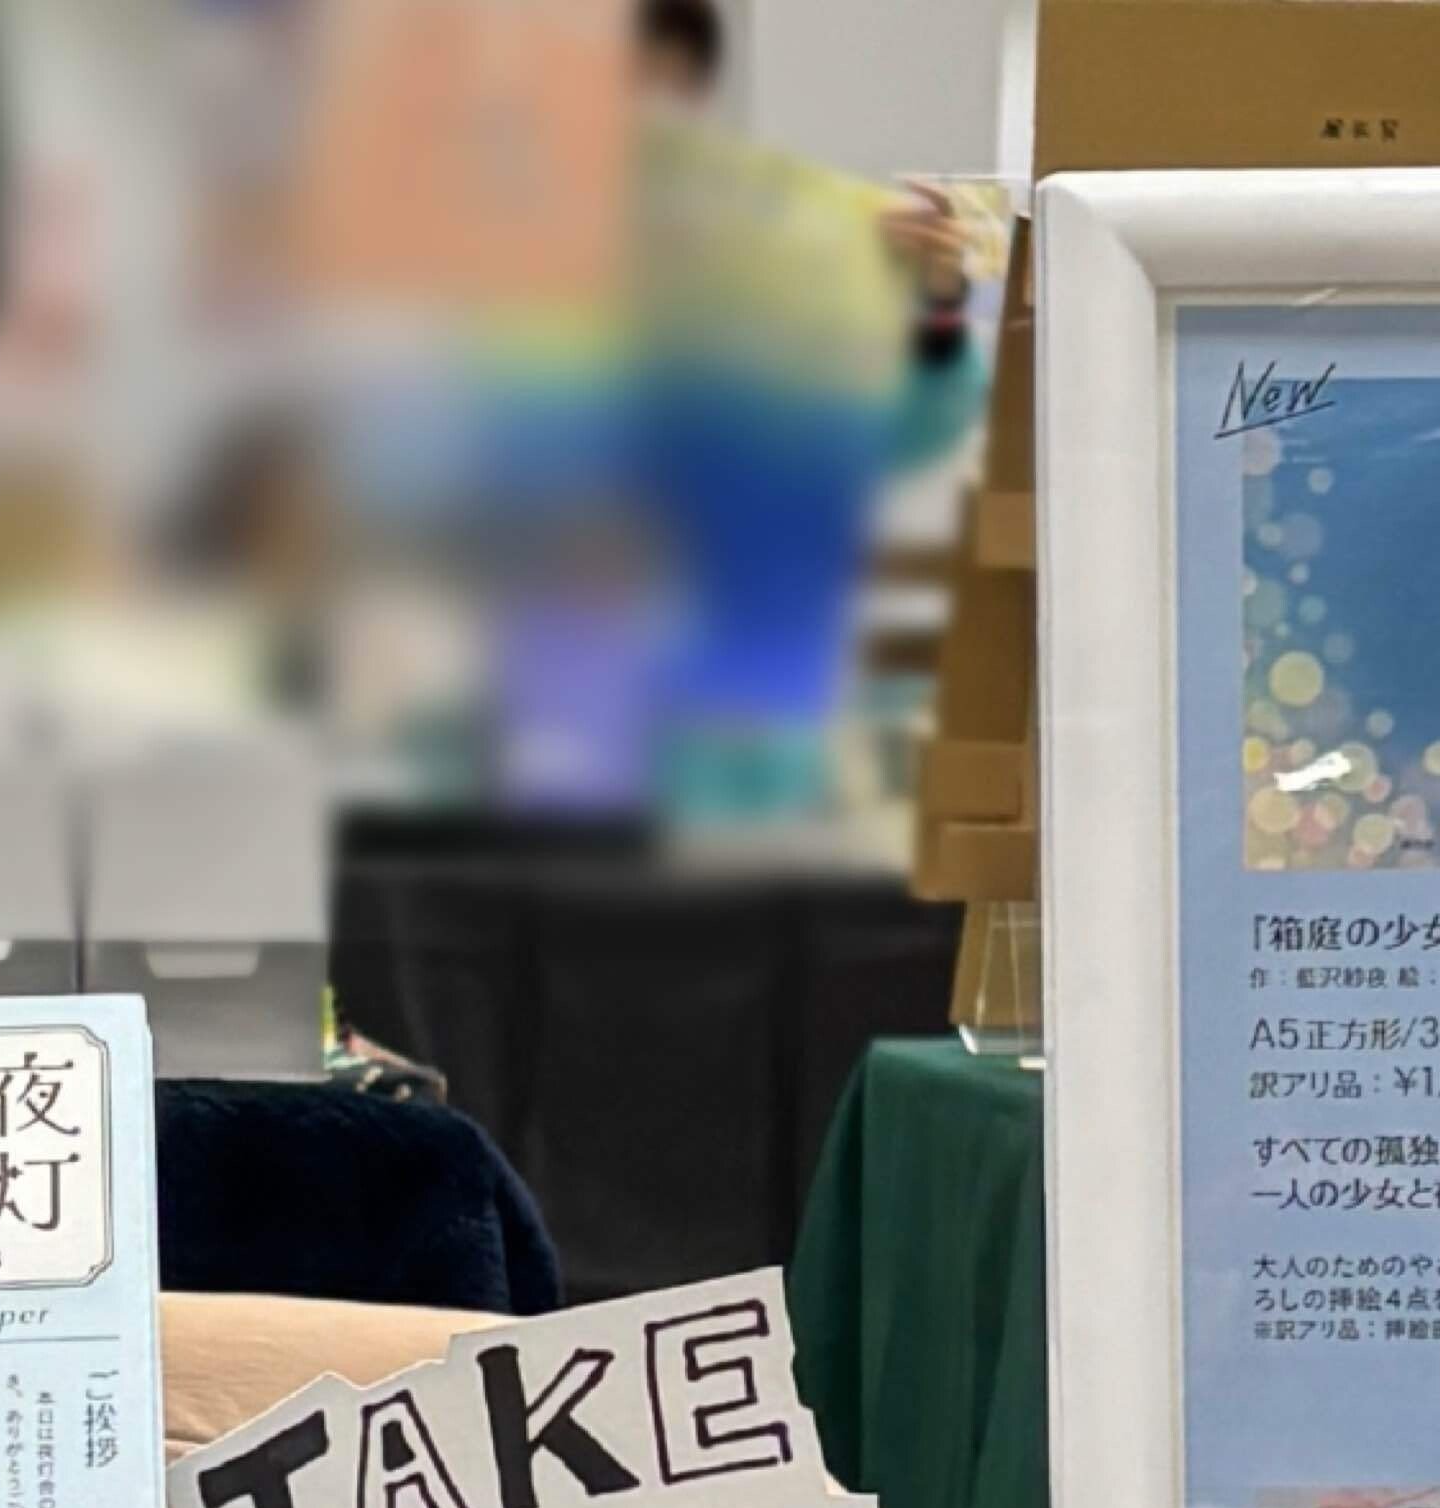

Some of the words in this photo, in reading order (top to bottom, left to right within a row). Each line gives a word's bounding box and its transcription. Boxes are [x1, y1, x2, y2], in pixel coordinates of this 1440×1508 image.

[1221, 360, 1337, 430] New
[84, 1368, 120, 1470] ご挨拶
